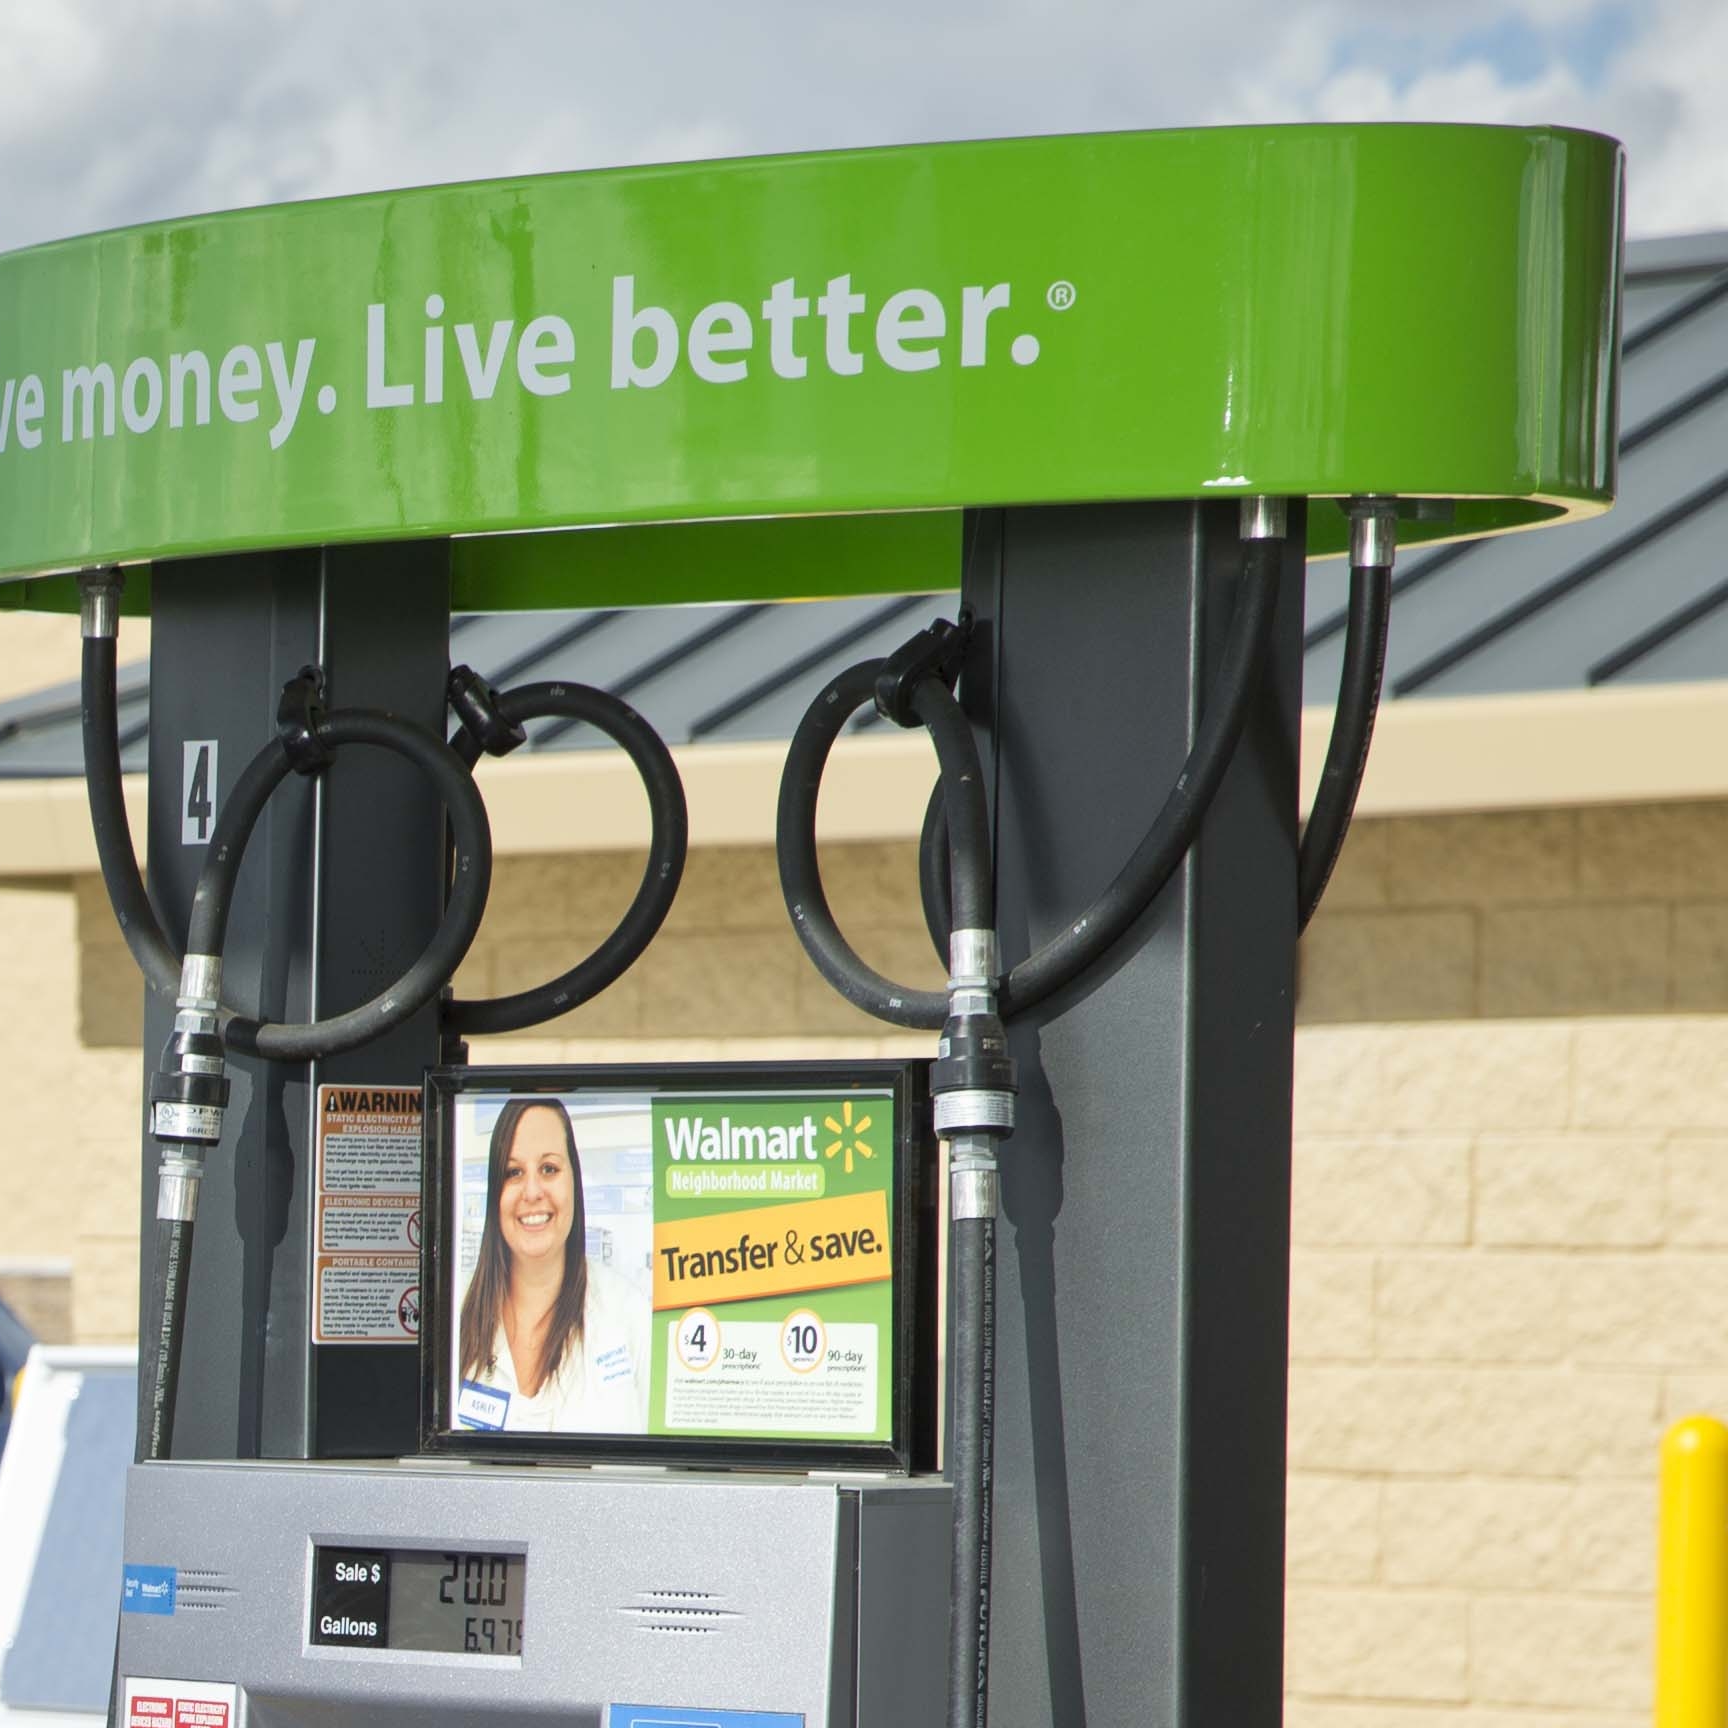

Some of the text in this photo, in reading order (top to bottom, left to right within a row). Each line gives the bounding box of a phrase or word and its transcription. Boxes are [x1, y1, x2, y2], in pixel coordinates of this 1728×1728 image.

[61, 338, 337, 450] money.
[365, 295, 571, 409] Live
[187, 746, 212, 840] 4
[339, 1091, 422, 1113] WARNIN
[664, 1115, 818, 1161] Walmart
[671, 1170, 818, 1195] Neighborhood Market
[660, 1228, 883, 1281] Transfer & save.
[722, 1348, 758, 1363] 30-day
[827, 1350, 863, 1365] 90-day
[471, 1398, 497, 1415] ASHLEY
[334, 1563, 367, 1583] Sale
[371, 1563, 381, 1585] $
[320, 1615, 378, 1637] Gallons
[977, 1588, 988, 1689] FUTURA
